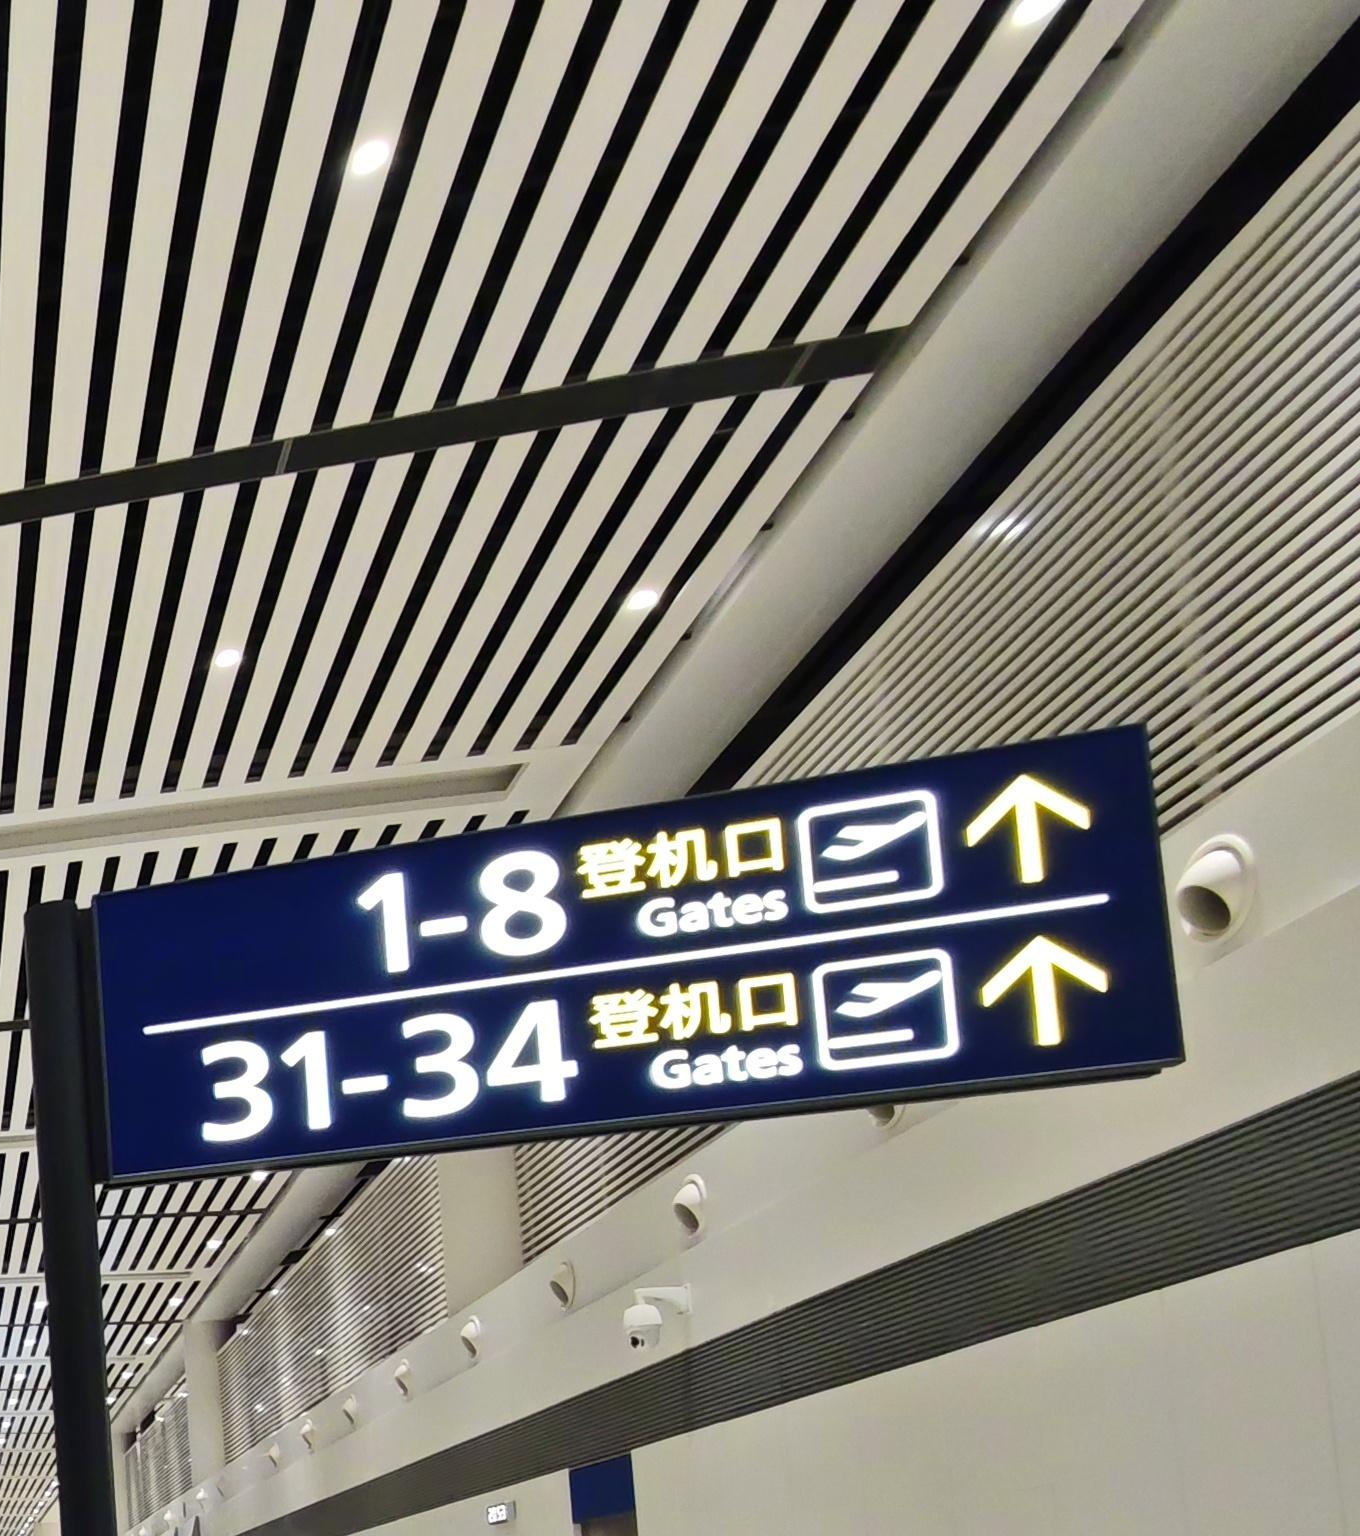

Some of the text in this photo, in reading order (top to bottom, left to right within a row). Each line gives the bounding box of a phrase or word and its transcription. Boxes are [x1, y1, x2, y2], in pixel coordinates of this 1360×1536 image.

[578, 819, 784, 897] 登机口
[357, 851, 567, 972] 1-8
[636, 890, 788, 937] Gates
[590, 974, 798, 1049] 登机口
[202, 1000, 578, 1142] 31-34
[649, 1045, 803, 1089] Gates
